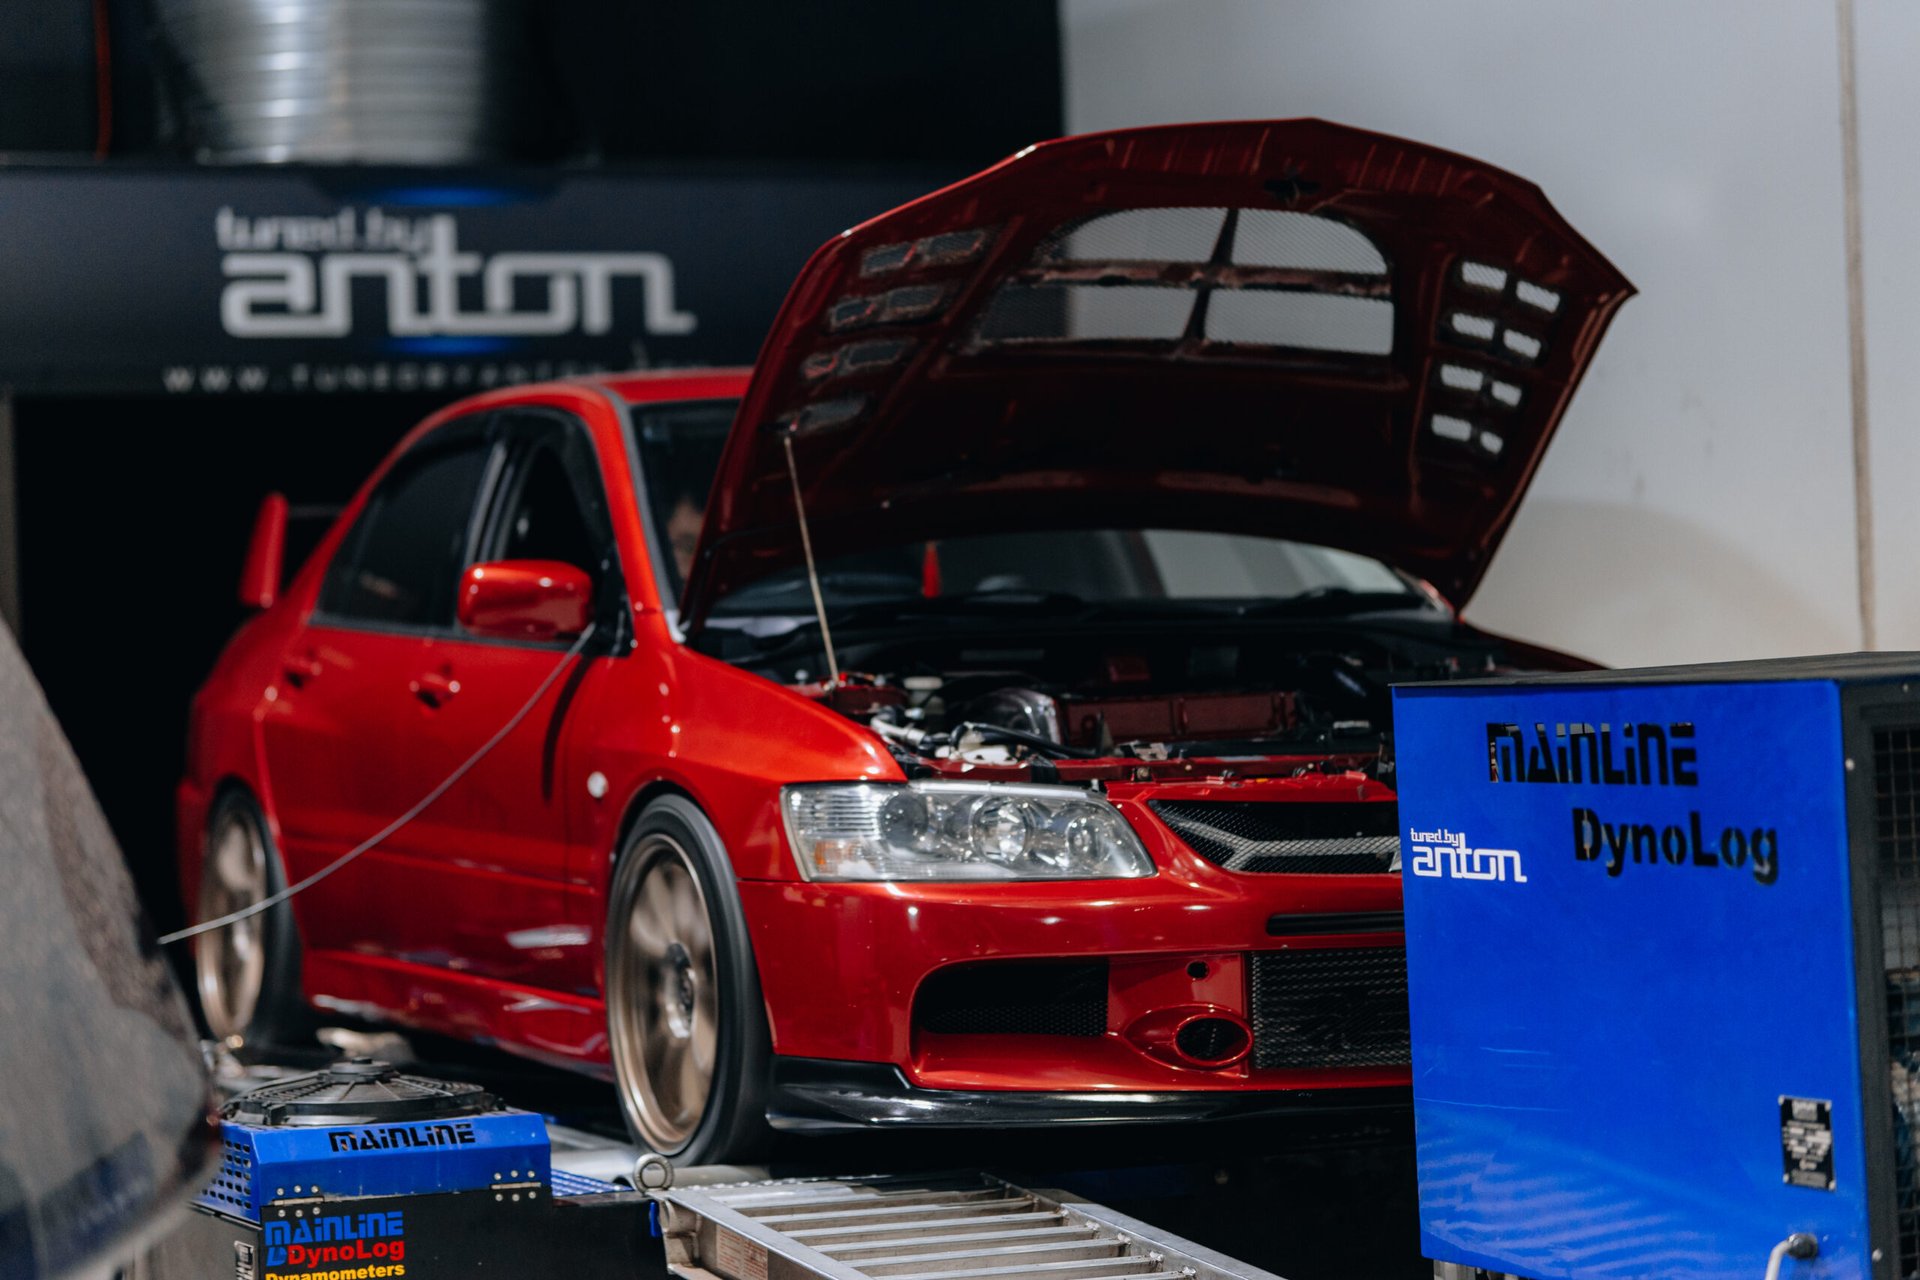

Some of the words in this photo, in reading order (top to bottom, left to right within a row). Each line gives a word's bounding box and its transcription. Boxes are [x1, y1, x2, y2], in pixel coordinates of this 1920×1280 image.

[219, 213, 696, 337] anton
[1410, 828, 1442, 844] tuned
[1443, 828, 1459, 847] by
[1412, 832, 1528, 883] anton
[1572, 808, 1779, 886] DynoLog
